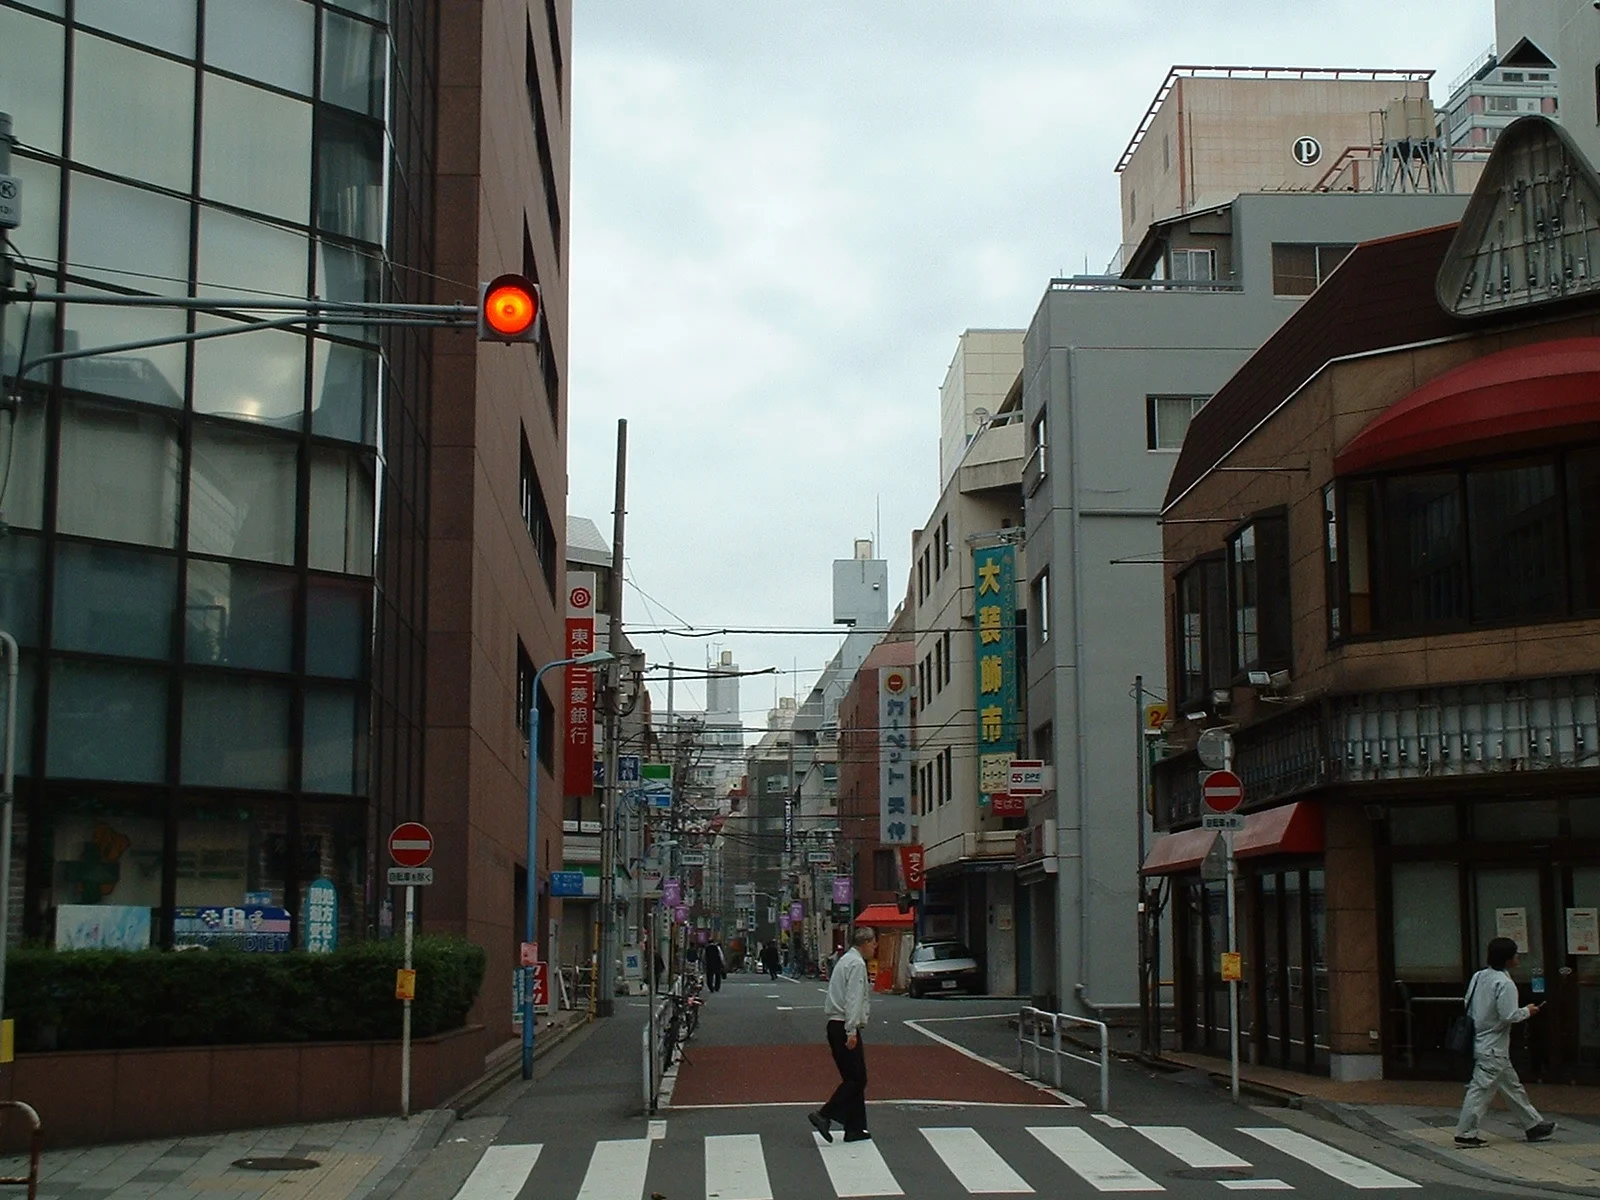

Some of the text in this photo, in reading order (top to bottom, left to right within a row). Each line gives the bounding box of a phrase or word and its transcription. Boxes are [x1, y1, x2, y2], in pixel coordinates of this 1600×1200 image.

[569, 628, 589, 745] 東京三菱銀行
